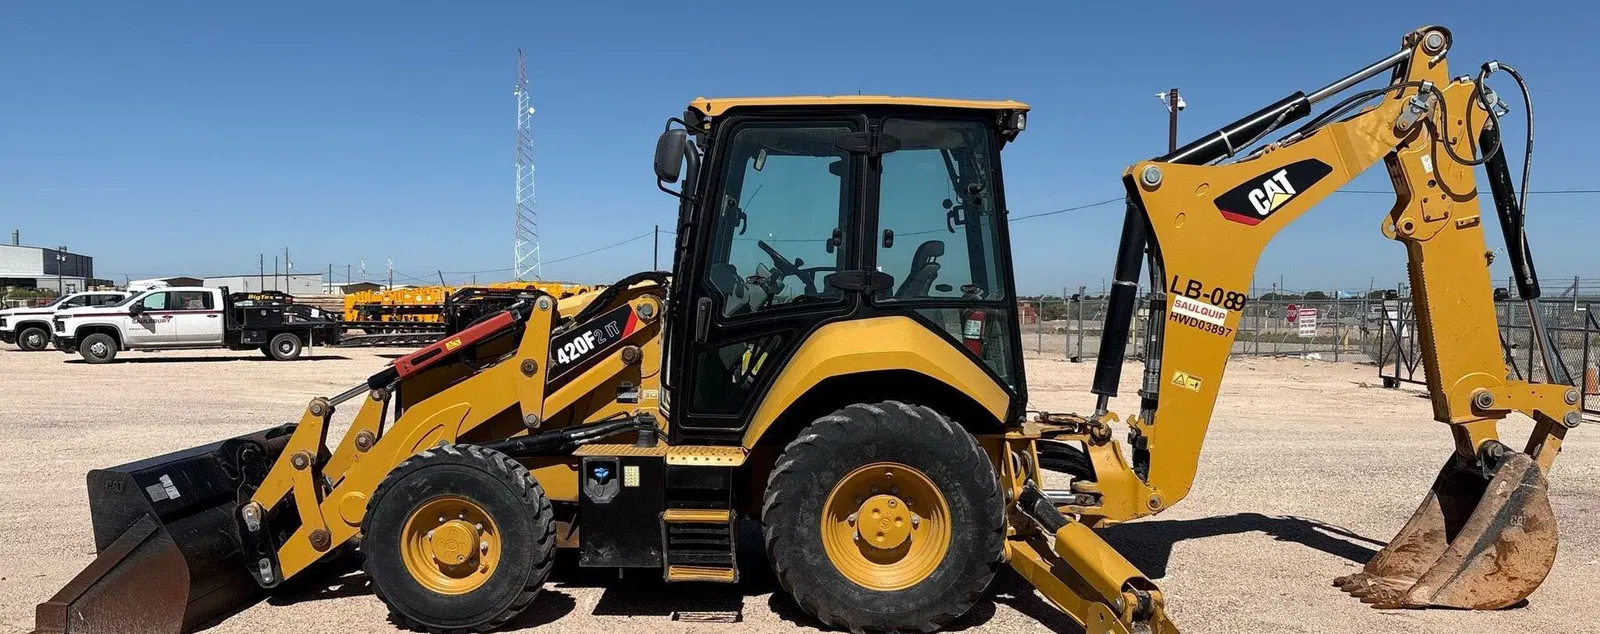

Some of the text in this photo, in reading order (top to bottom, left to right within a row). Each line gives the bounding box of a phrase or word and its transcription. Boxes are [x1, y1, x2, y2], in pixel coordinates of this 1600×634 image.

[1248, 168, 1297, 216] CAT
[1169, 274, 1247, 312] LB-089
[1169, 311, 1233, 338] HWD03897
[1174, 299, 1226, 320] SAULQUIP
